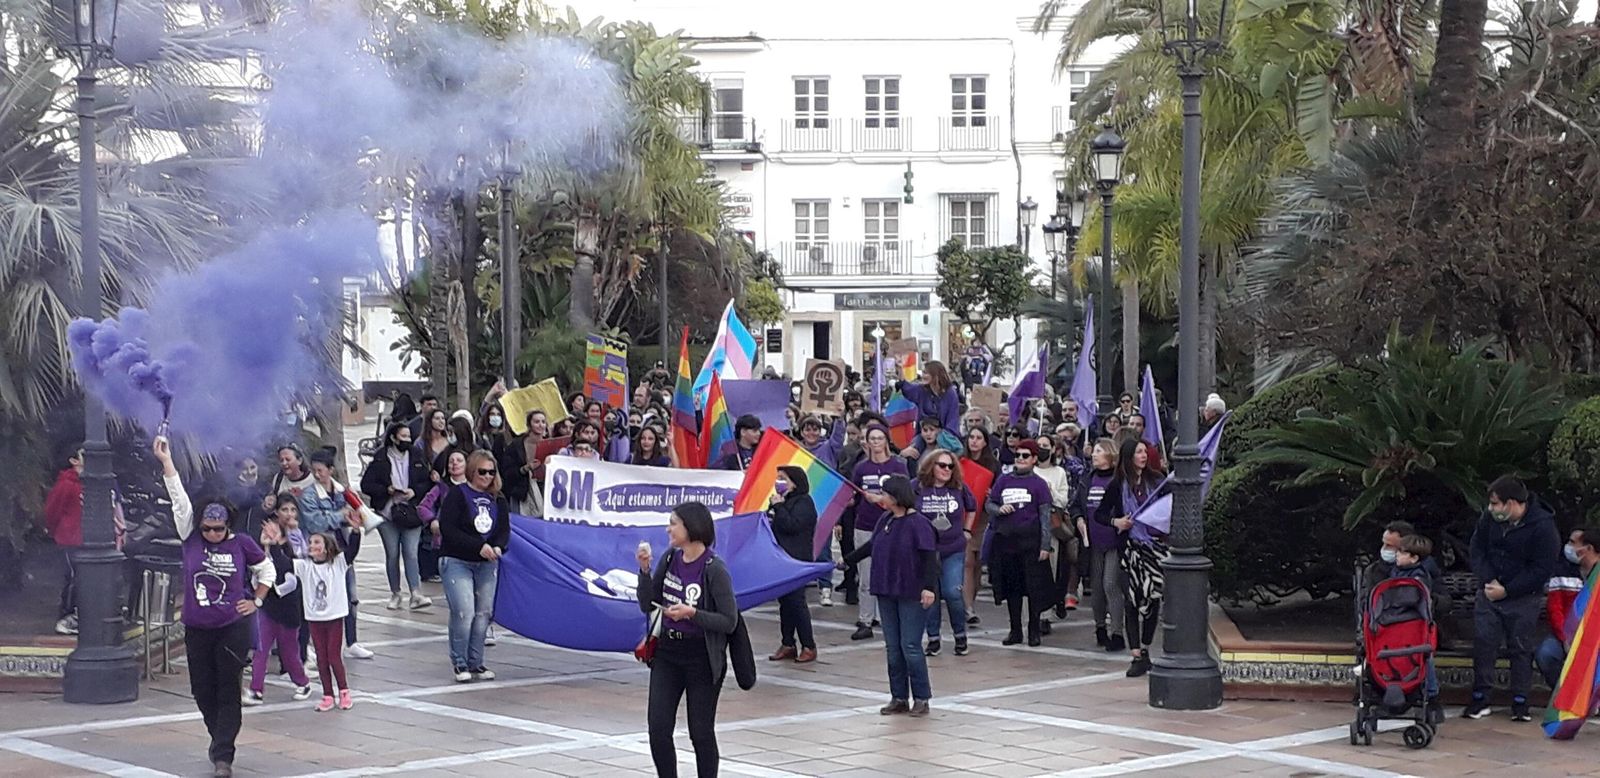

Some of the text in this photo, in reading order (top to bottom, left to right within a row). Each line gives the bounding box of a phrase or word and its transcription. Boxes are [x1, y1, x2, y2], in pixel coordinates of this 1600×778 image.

[843, 294, 921, 308] farmacia peral
[551, 468, 595, 511] 8M
[604, 487, 724, 510] Aquí estamos las feministas
